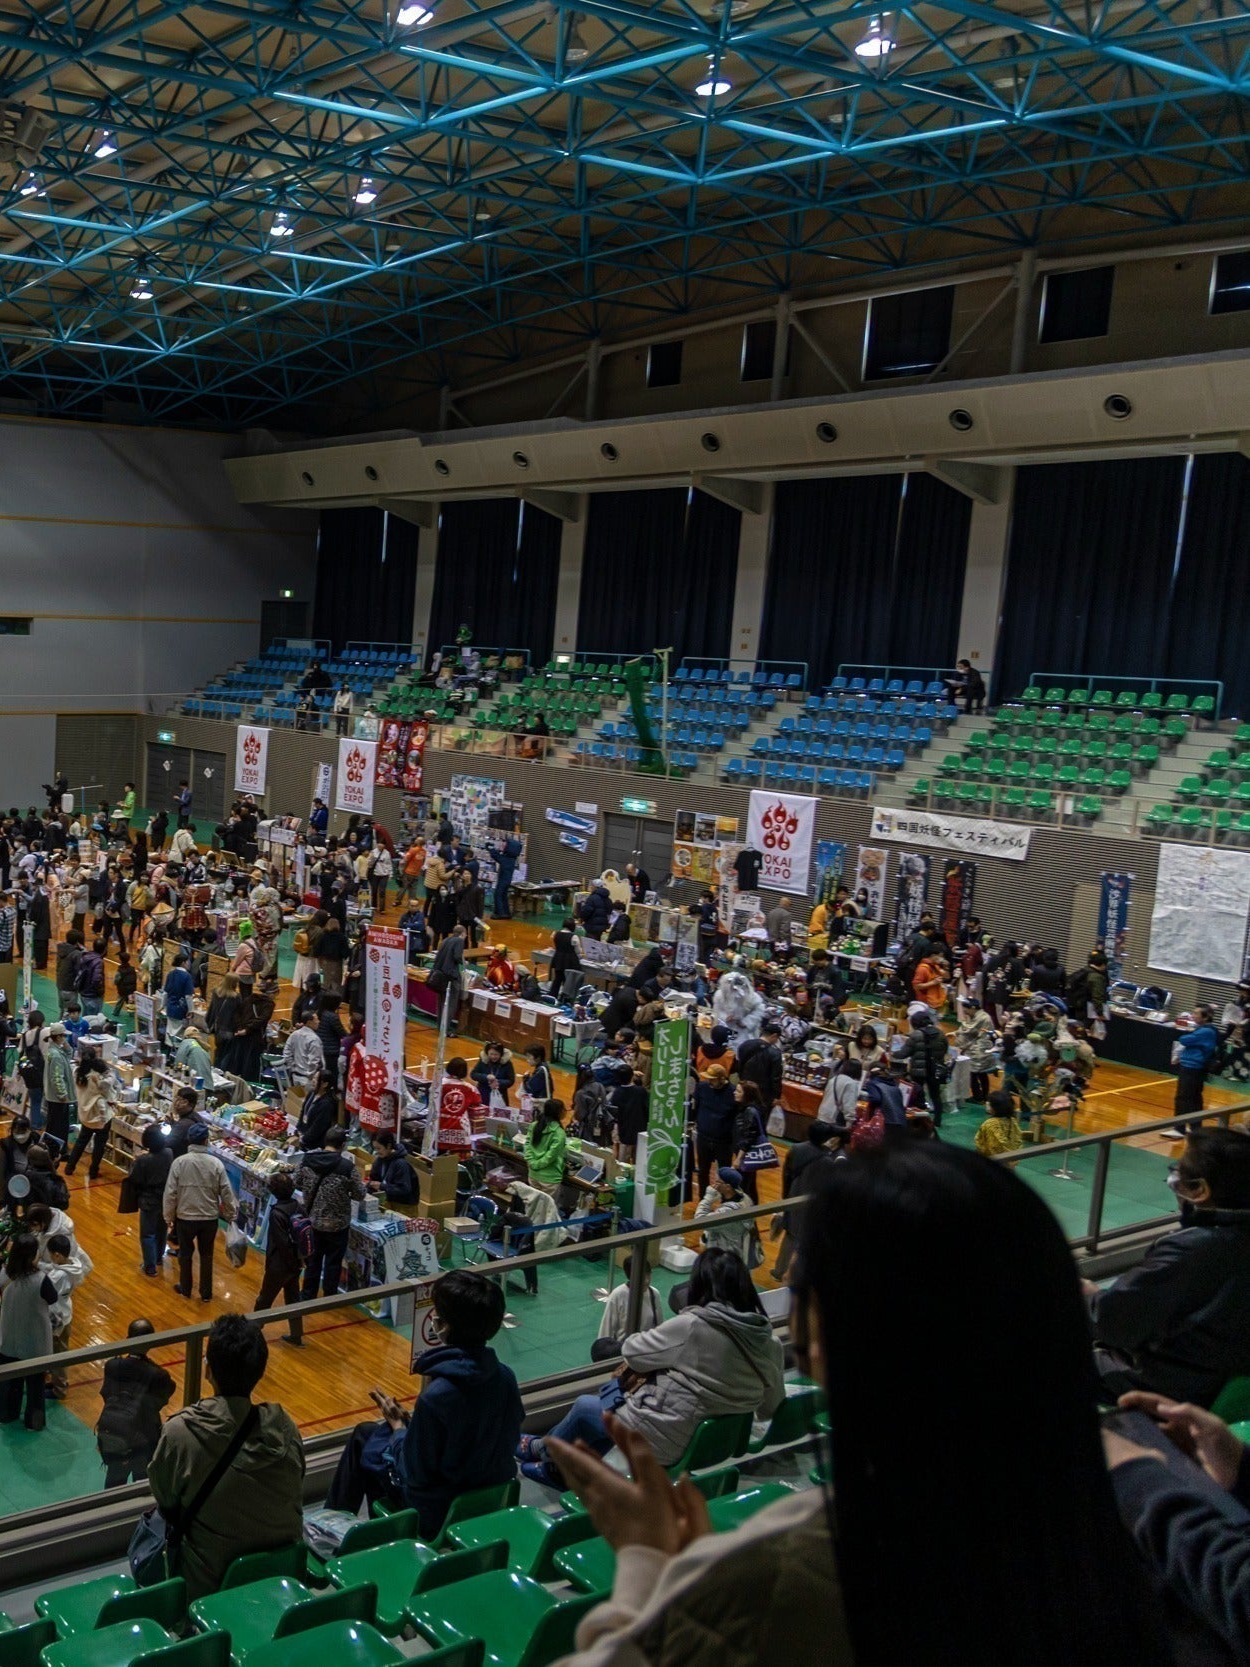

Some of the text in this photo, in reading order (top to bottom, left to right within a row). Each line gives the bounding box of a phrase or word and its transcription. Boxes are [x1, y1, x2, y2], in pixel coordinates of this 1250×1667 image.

[241, 768, 259, 777] YOKAI
[241, 776, 258, 785] EXPO
[344, 785, 364, 795] YOKAI
[343, 793, 364, 804] EXPO
[897, 821, 1025, 849] 四国妖怪フェスティバル
[376, 1217, 440, 1247] 小豆島新名物
